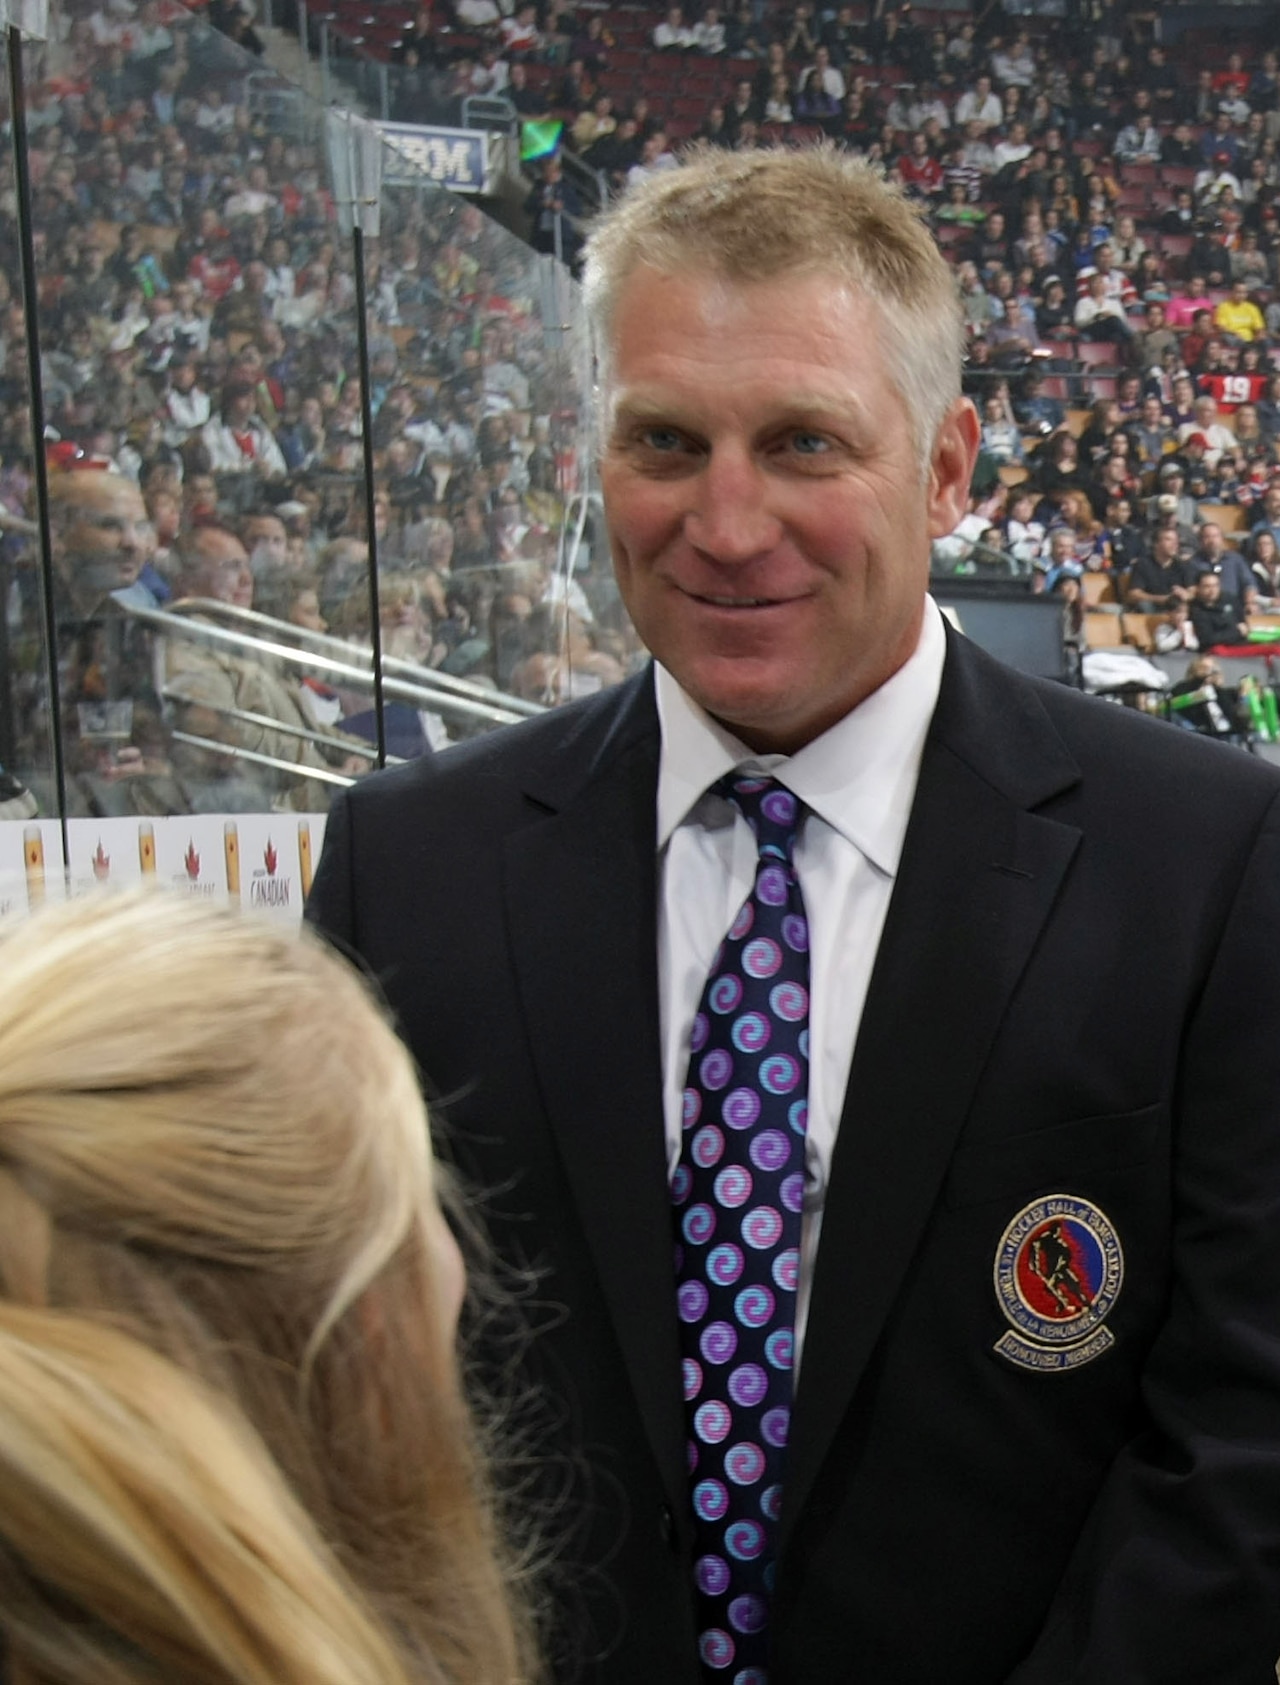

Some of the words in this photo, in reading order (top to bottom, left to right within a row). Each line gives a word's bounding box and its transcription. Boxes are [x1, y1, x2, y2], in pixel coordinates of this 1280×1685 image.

[1221, 376, 1251, 403] 19
[250, 877, 292, 907] CANADIAN
[1046, 1201, 1077, 1216] HALL
